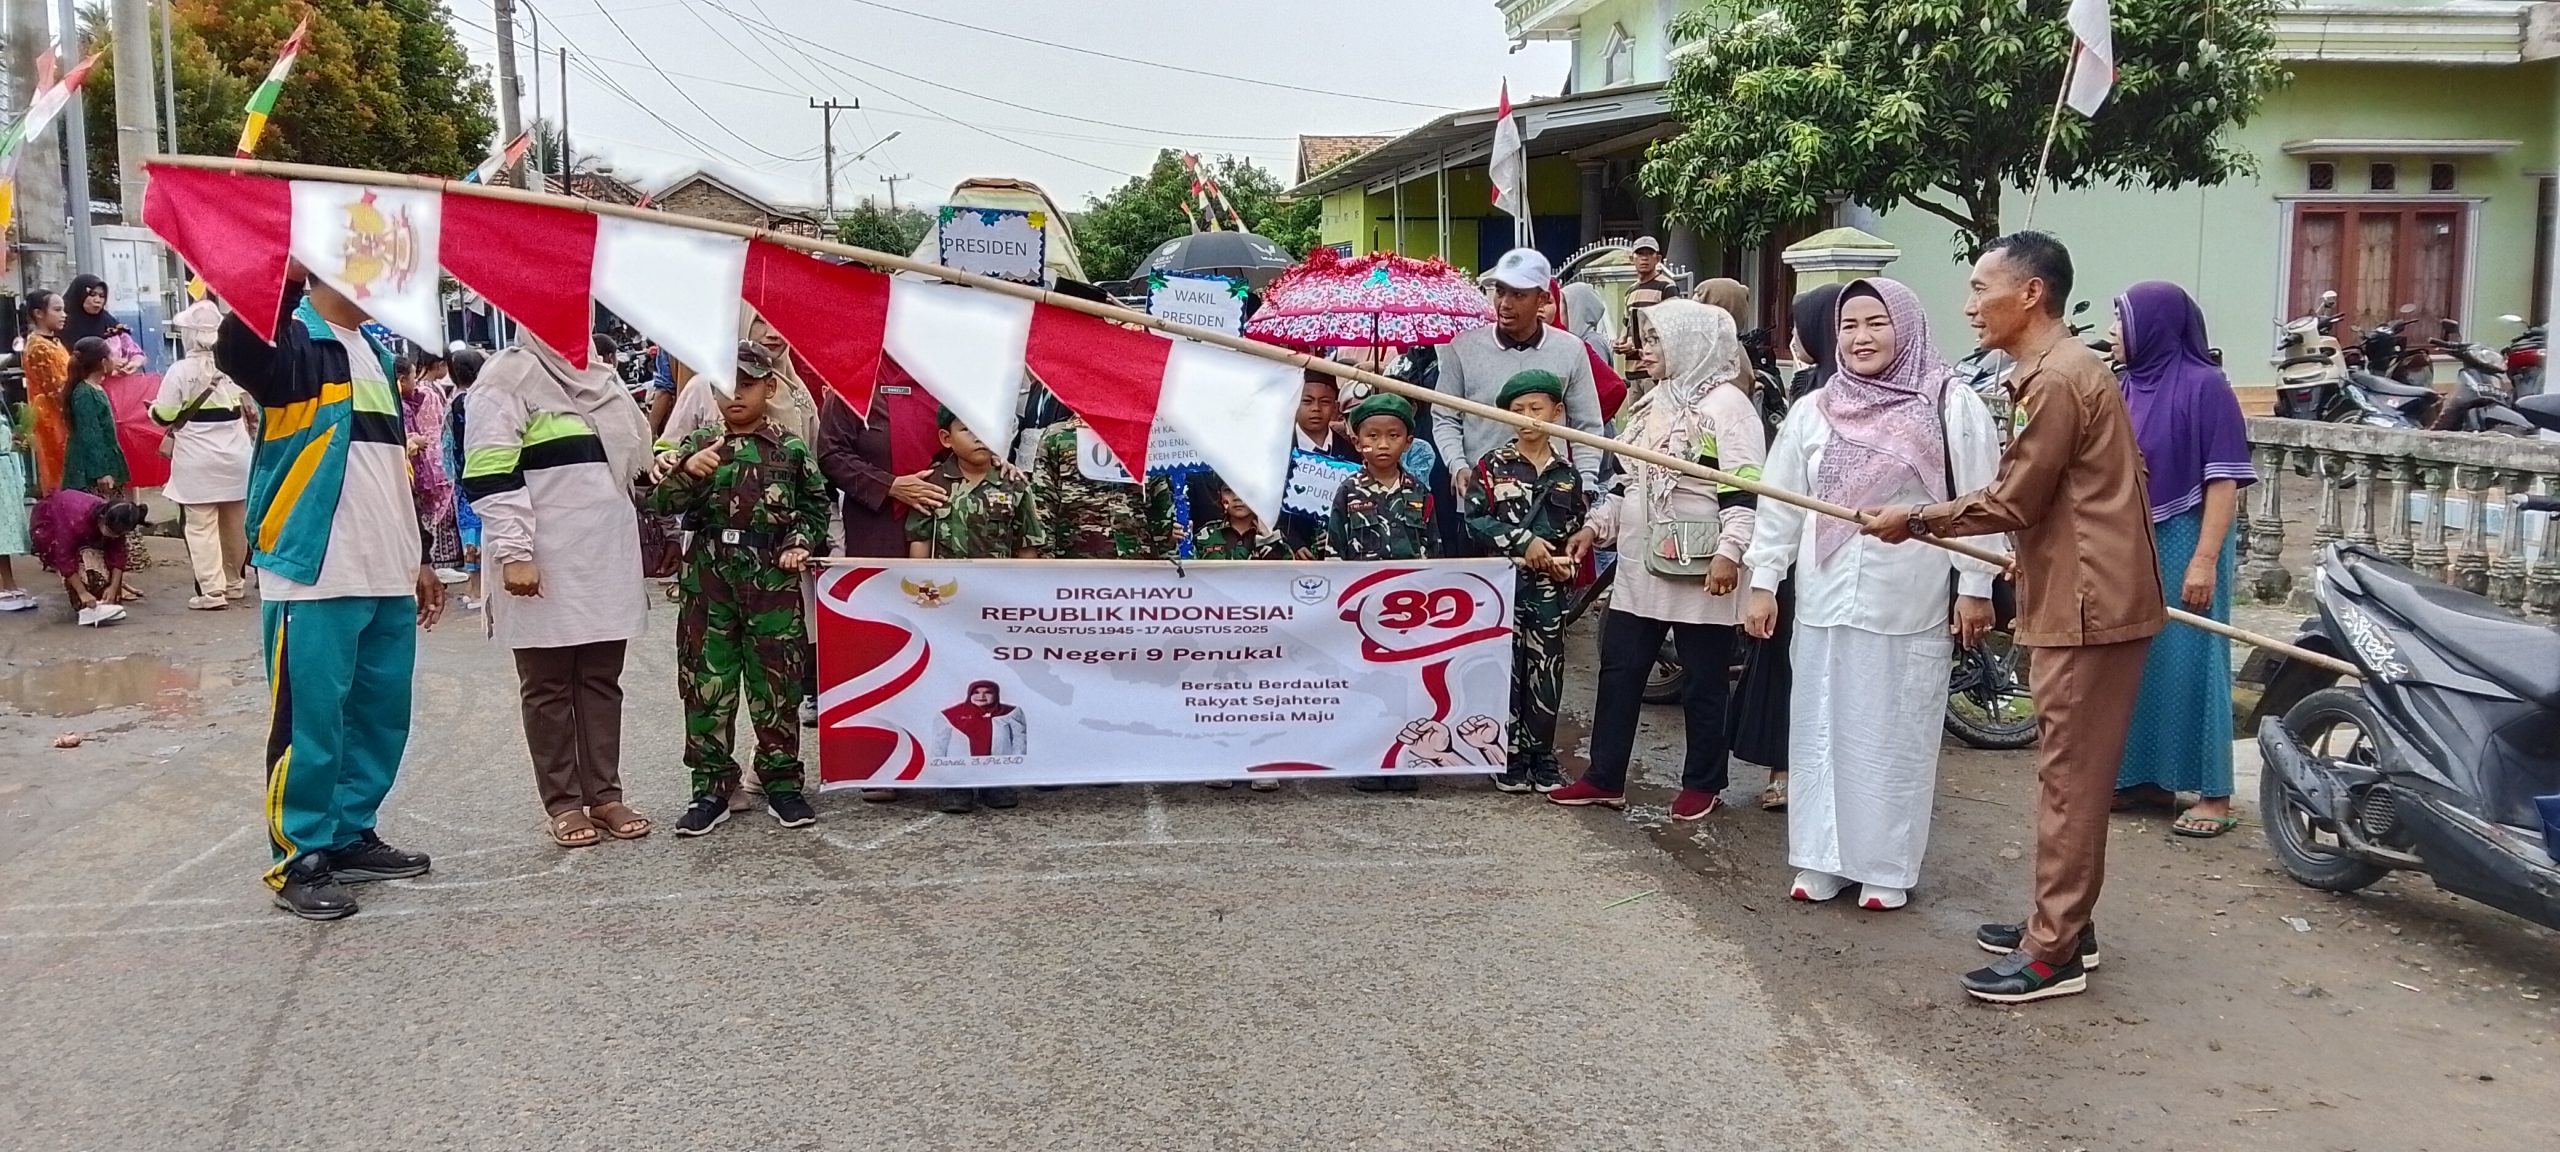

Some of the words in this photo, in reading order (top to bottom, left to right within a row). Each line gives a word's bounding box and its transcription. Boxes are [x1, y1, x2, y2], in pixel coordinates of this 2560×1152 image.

[944, 237, 1027, 256] PRESIDEN
[1174, 289, 1217, 305] WAKIL
[1162, 310, 1225, 328] PRESIDEN
[1148, 452, 1170, 462] EKEH
[1296, 461, 1336, 481] KEPALA
[1056, 587, 1193, 600] DIRGAHAYU
[981, 606, 1124, 622] REPUBLIK
[1129, 606, 1294, 621] INDONESIA!
[1378, 588, 1475, 629] 80
[1006, 625, 1023, 633] 17
[1024, 626, 1097, 635] AGUSTUS
[1099, 626, 1134, 635] 1945
[1144, 626, 1160, 635] 17
[1162, 625, 1232, 635] AGUSTUS
[1234, 625, 1269, 634] 2025
[992, 646, 1033, 661] SD
[1043, 647, 1137, 664] Negeri
[1146, 648, 1163, 661] 9
[1173, 645, 1284, 662] Penukal
[1181, 681, 1253, 691] Bersatu
[1258, 678, 1349, 690] Berdaulat
[1185, 695, 1248, 709] Rakyat
[1252, 694, 1341, 708] Sejahtera
[1194, 711, 1286, 723] Indonesia
[1290, 710, 1335, 724] Maju
